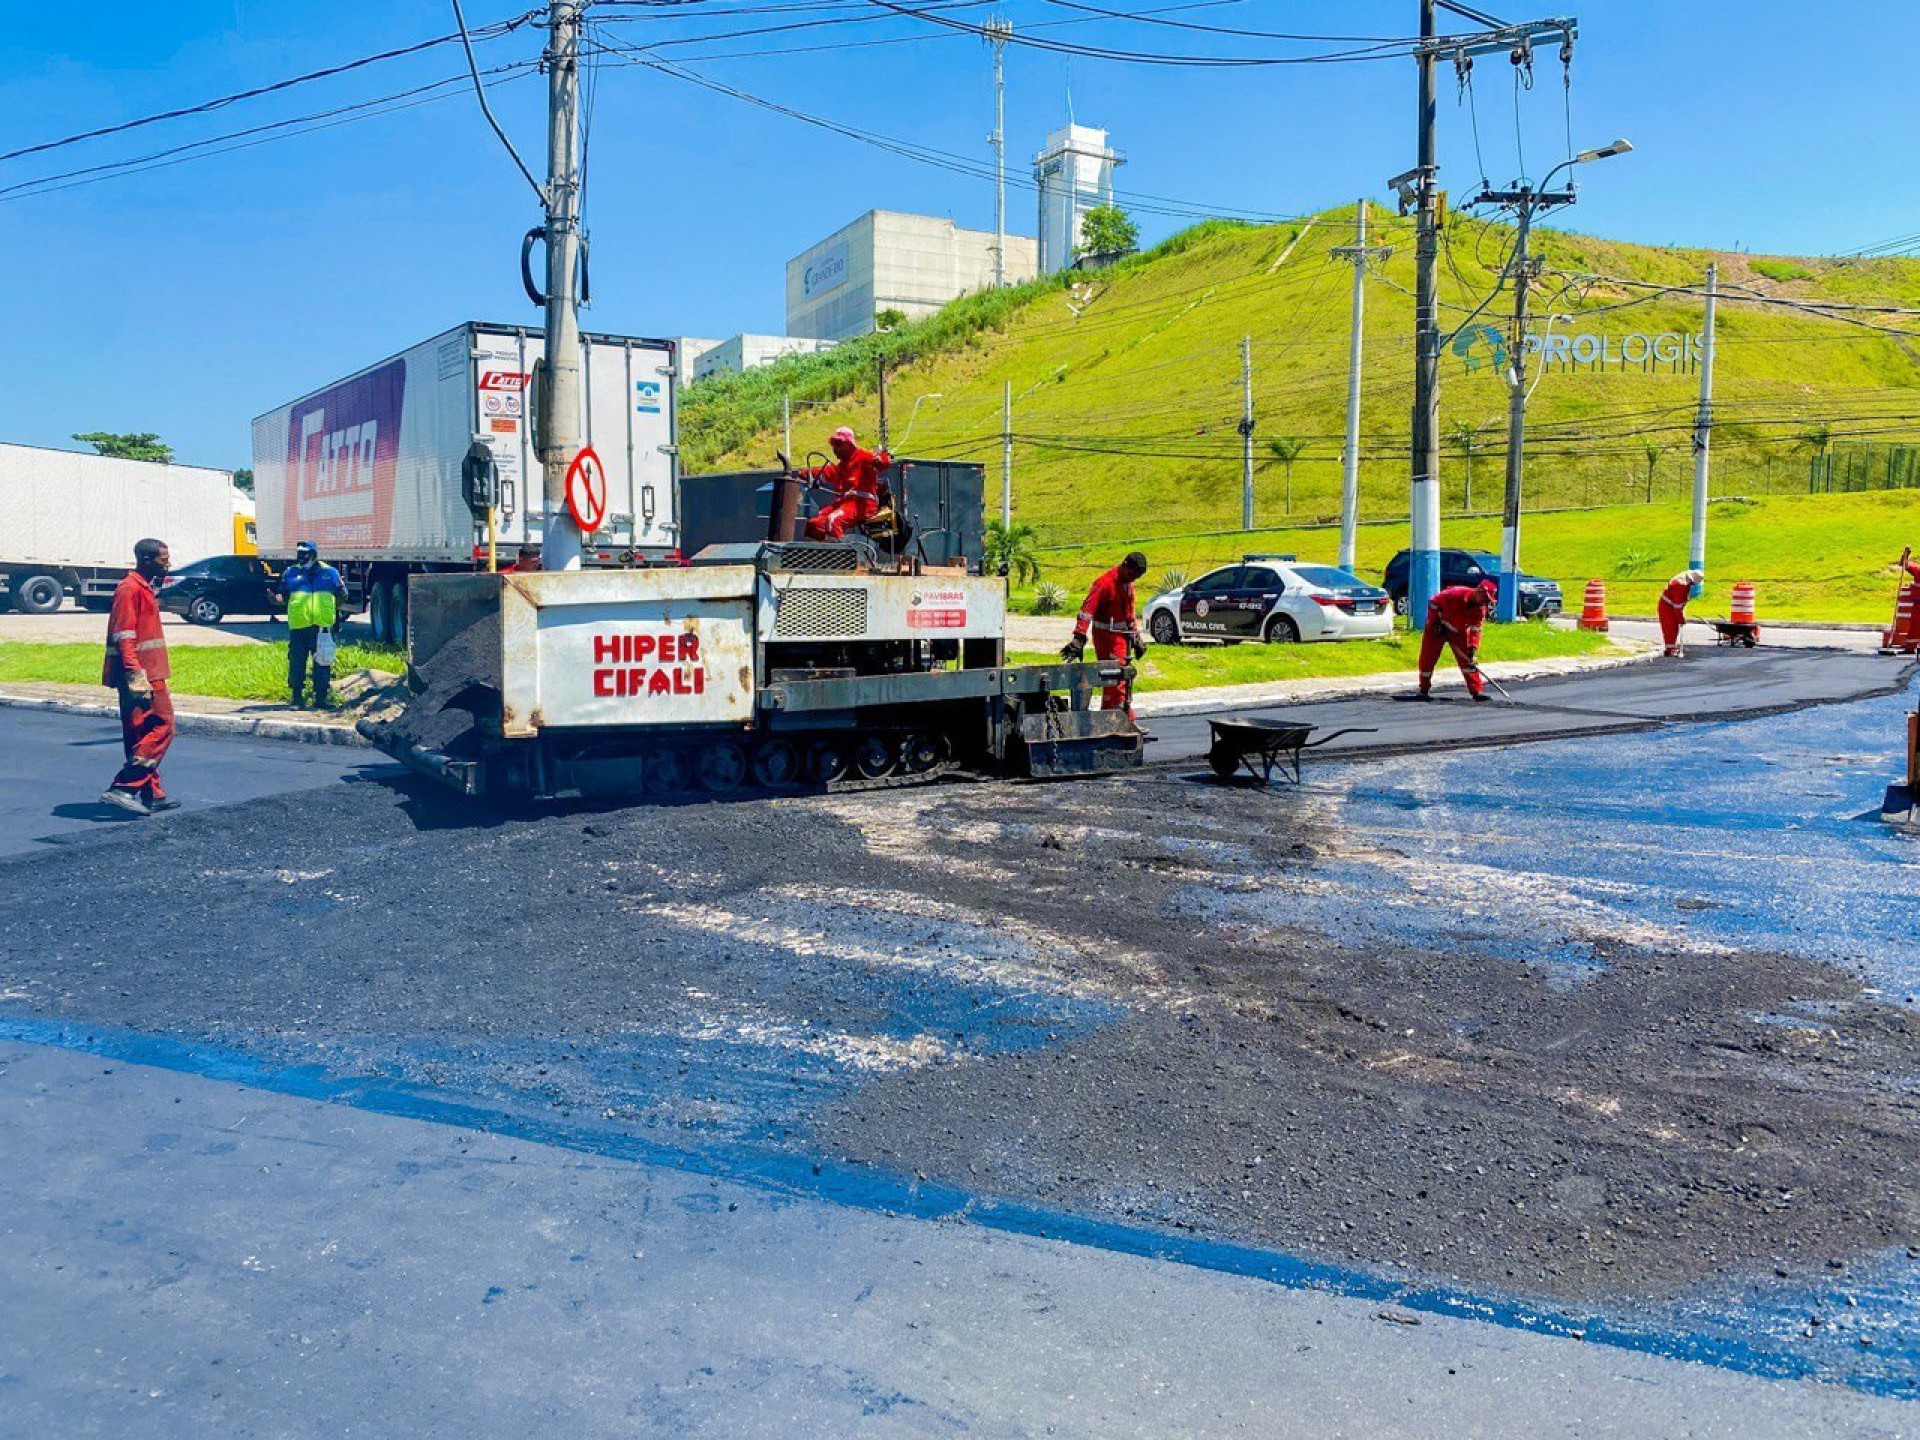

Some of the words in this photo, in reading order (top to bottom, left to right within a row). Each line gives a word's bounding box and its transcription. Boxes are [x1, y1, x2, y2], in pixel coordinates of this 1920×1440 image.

[297, 408, 378, 521] CATTO
[1208, 622, 1228, 631] CIVIL
[593, 633, 700, 663] HIPER
[593, 667, 705, 698] CIFALI
